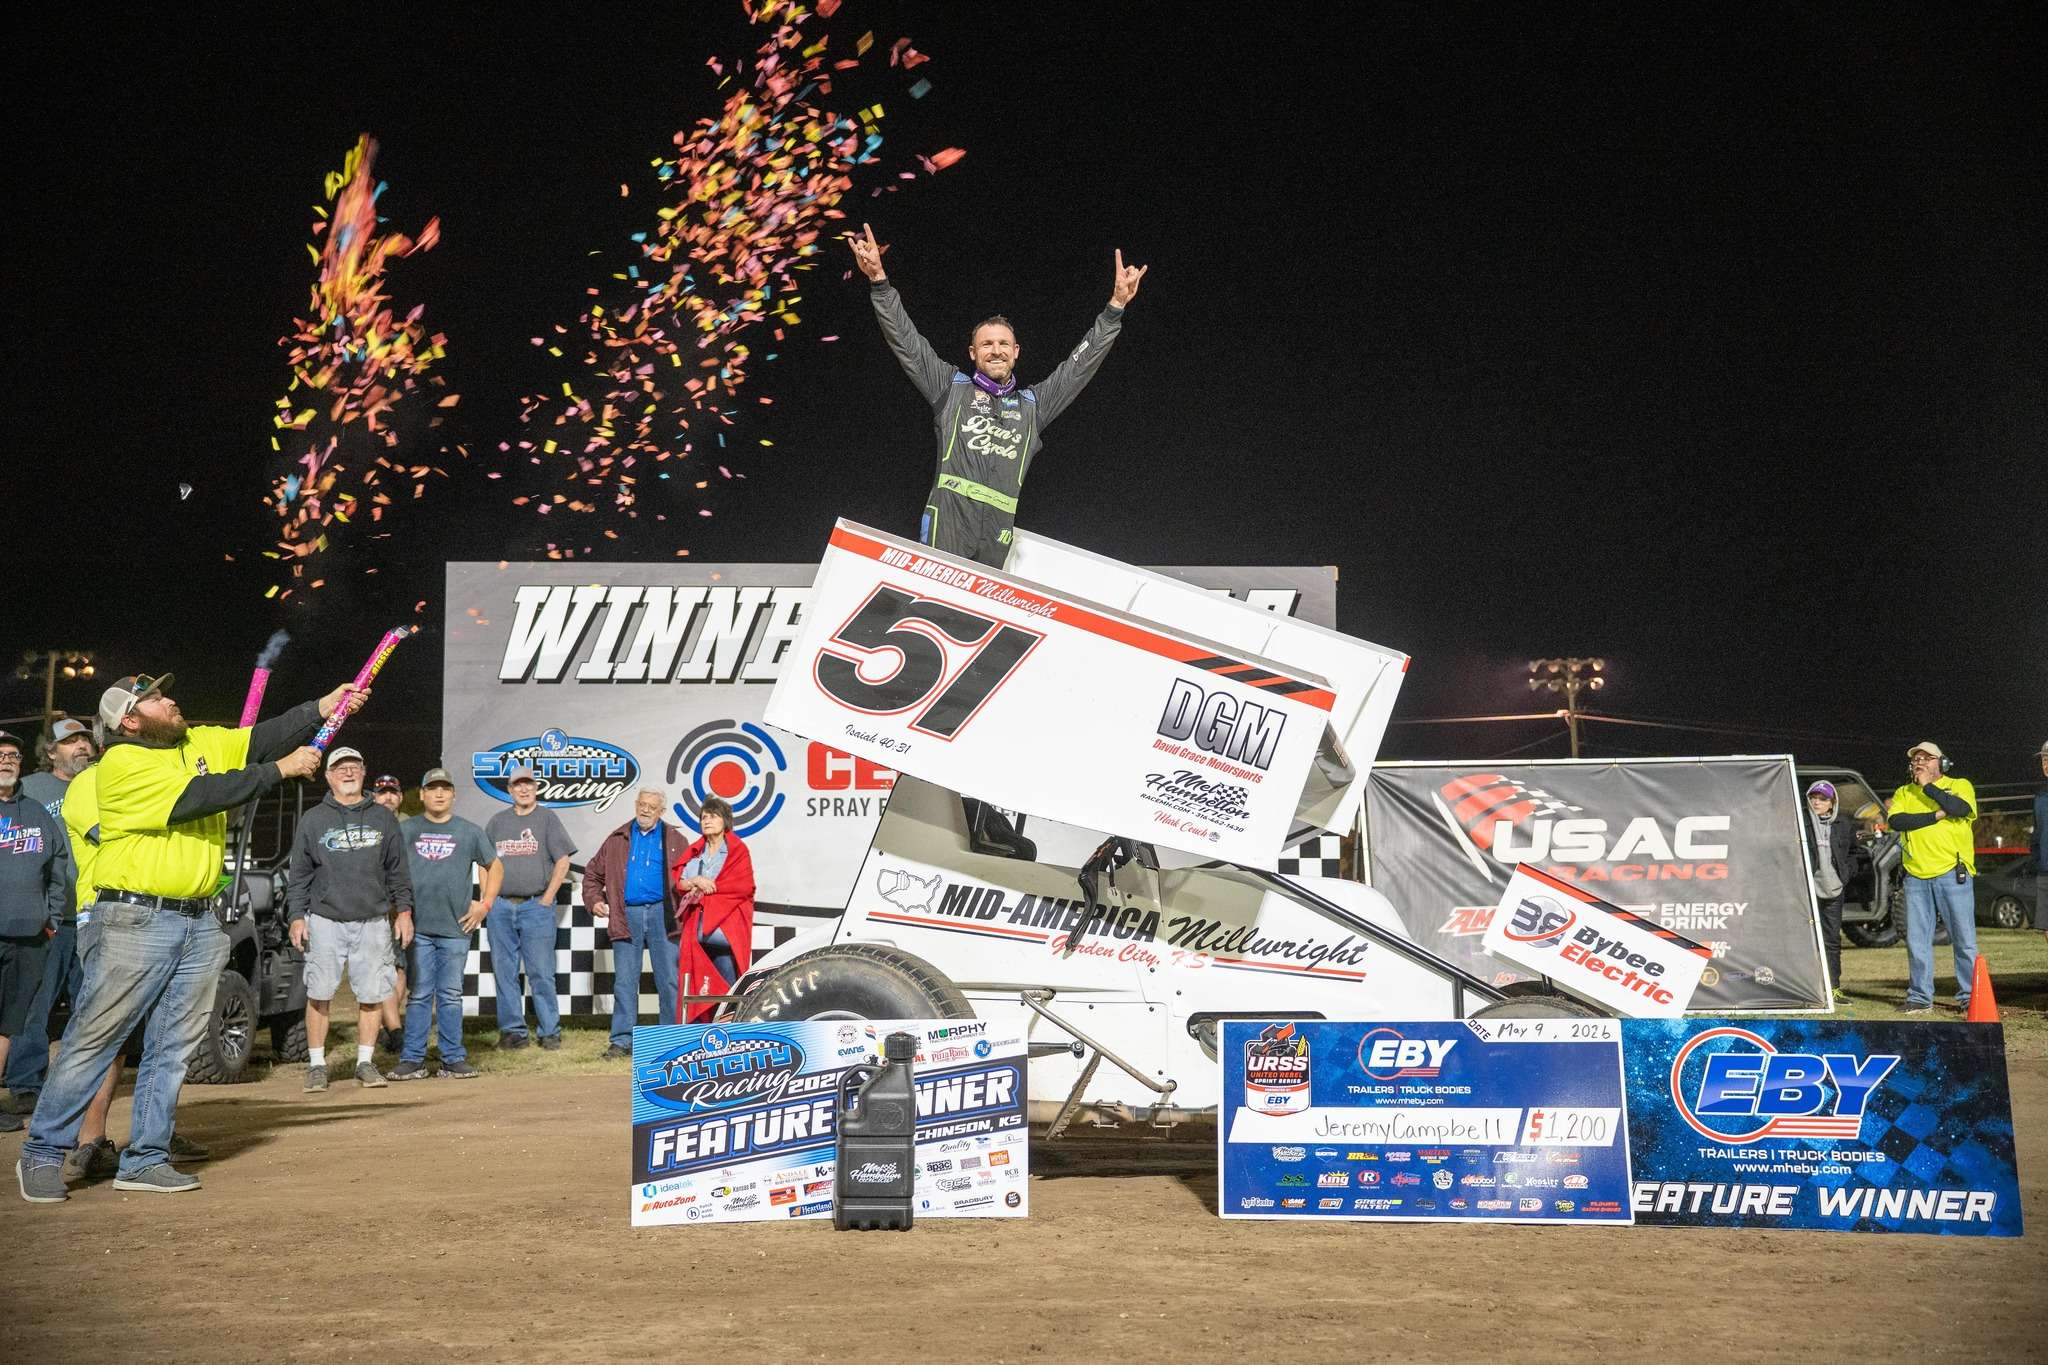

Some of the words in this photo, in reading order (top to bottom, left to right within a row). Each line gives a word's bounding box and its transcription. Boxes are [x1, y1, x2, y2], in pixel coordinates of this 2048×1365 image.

[962, 415, 1022, 444] Dan's
[879, 547, 977, 592] MID-AMERICA
[975, 578, 1059, 618] Millwright
[1157, 678, 1287, 771] DGM
[845, 724, 877, 744] Isaiah
[879, 736, 912, 755] 40:31
[1153, 739, 1180, 756] David
[1179, 747, 1207, 765] Grace
[1206, 757, 1264, 784] Motorsports
[806, 797, 873, 817] SPRAY
[1491, 815, 1731, 863] USAC
[1660, 902, 1749, 916] ENERGY
[1660, 916, 1728, 930] DRINK
[1167, 915, 1368, 971] Millwright
[1572, 925, 1666, 978] Bybee
[1559, 944, 1675, 1005] Electric
[1468, 1018, 1492, 1041] DATE
[1497, 1022, 1528, 1039] May
[1534, 1022, 1544, 1037] 9
[1571, 1023, 1612, 1040] 2026
[637, 1043, 793, 1091] SALTCITY
[1247, 1056, 1309, 1071] URSS
[1367, 1039, 1459, 1068] EBY
[682, 1069, 793, 1113] Racing
[1347, 1085, 1395, 1094] TRAILERS
[1399, 1085, 1434, 1094] TRUCK
[1435, 1085, 1472, 1094] BODIES
[1695, 1053, 1901, 1117] EBY
[1267, 1095, 1292, 1105] EBY
[1375, 1097, 1444, 1105] www.mheby.com
[650, 1098, 835, 1168] FEATURE
[998, 1114, 1022, 1127] KS
[1698, 1147, 1768, 1161] TRAILERS
[1778, 1148, 1828, 1162] TRUCK
[1831, 1149, 1886, 1163] BODIES
[1733, 1162, 1852, 1177] www.mheby.com
[1318, 1173, 1350, 1187] King
[1817, 1185, 1998, 1222] WINNER
